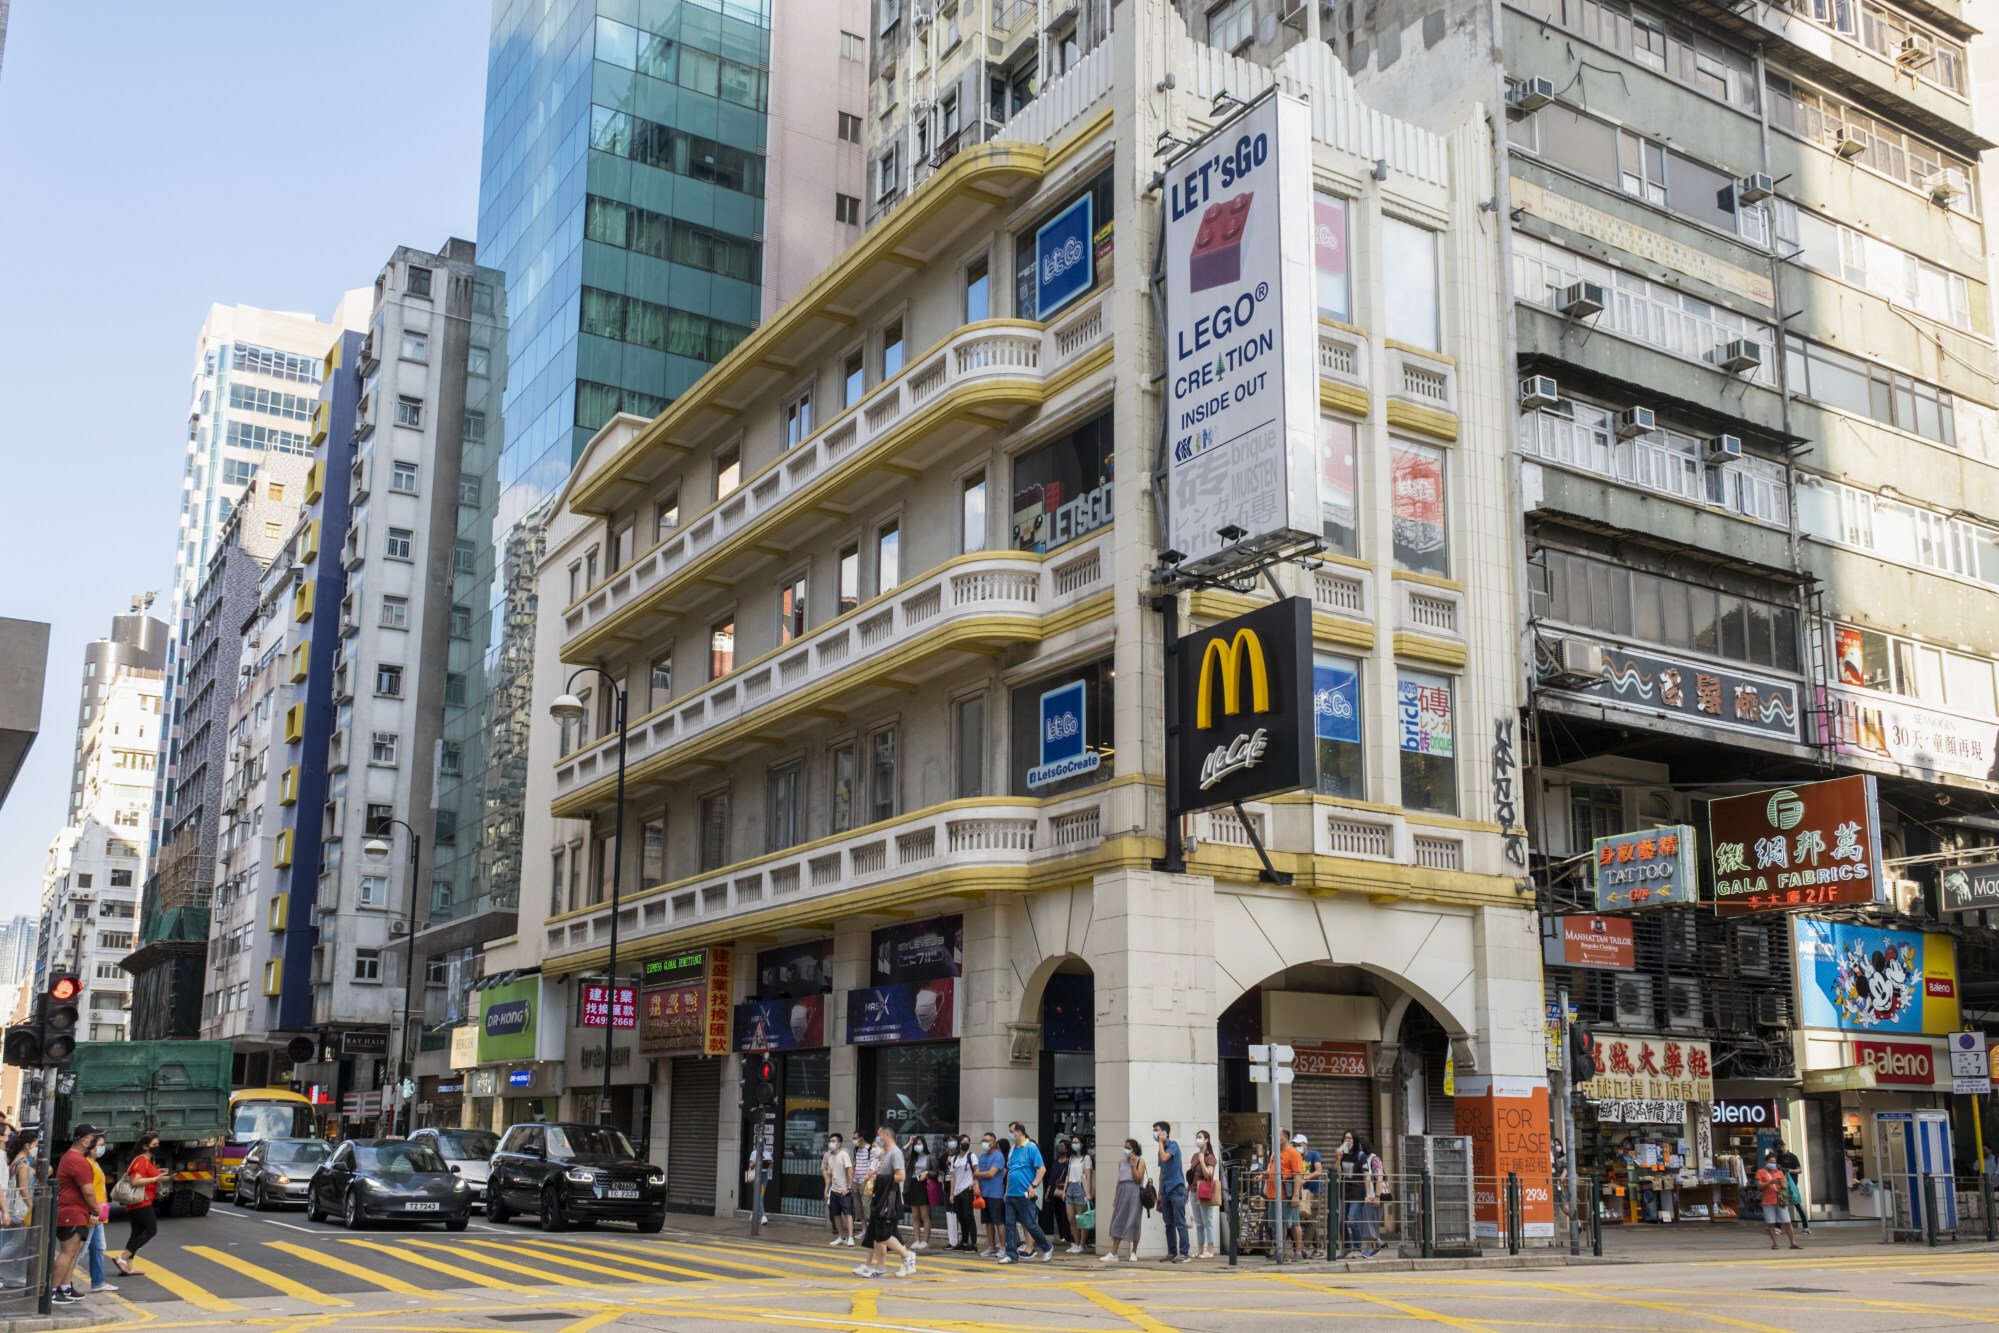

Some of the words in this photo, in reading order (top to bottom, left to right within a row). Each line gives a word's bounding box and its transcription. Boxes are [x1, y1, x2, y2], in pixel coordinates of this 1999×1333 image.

[1181, 395, 1229, 430] INSIDE
[1234, 372, 1267, 403] OUT
[1231, 429, 1277, 466] brique
[1175, 450, 1230, 511] 砖
[1231, 455, 1278, 501] MURSTEN
[1175, 493, 1230, 531] レンガ
[1417, 685, 1450, 718] 磚
[1400, 694, 1420, 752] brick
[1420, 715, 1450, 735] レンガ
[1200, 728, 1268, 783] McCafé
[1430, 732, 1452, 756] brique
[1037, 755, 1098, 781] LetsGoCreate
[1605, 862, 1674, 885] TATTOO
[1717, 876, 1768, 896] GALA
[1777, 863, 1869, 889] FABRICS
[1805, 886, 1838, 904] 2/F
[1565, 929, 1608, 943] MANHATTAN
[1609, 936, 1632, 946] TAILOR
[709, 946, 730, 1052] 建盛業找換匯款
[1929, 982, 1950, 993] Baleno
[613, 1017, 634, 1027] 2668
[1292, 1056, 1326, 1072] 2529
[1331, 1057, 1365, 1074] 2936
[1864, 1046, 1929, 1077] Baleno
[1974, 1053, 1980, 1062] 7
[1975, 1066, 1981, 1074] 7
[1456, 1108, 1481, 1124] FOR
[1497, 1108, 1532, 1129] FOR
[1712, 1100, 1766, 1123] aleno
[1498, 1132, 1547, 1154] LEASE
[1477, 1191, 1495, 1203] 2936
[1526, 1188, 1548, 1201] 2936
